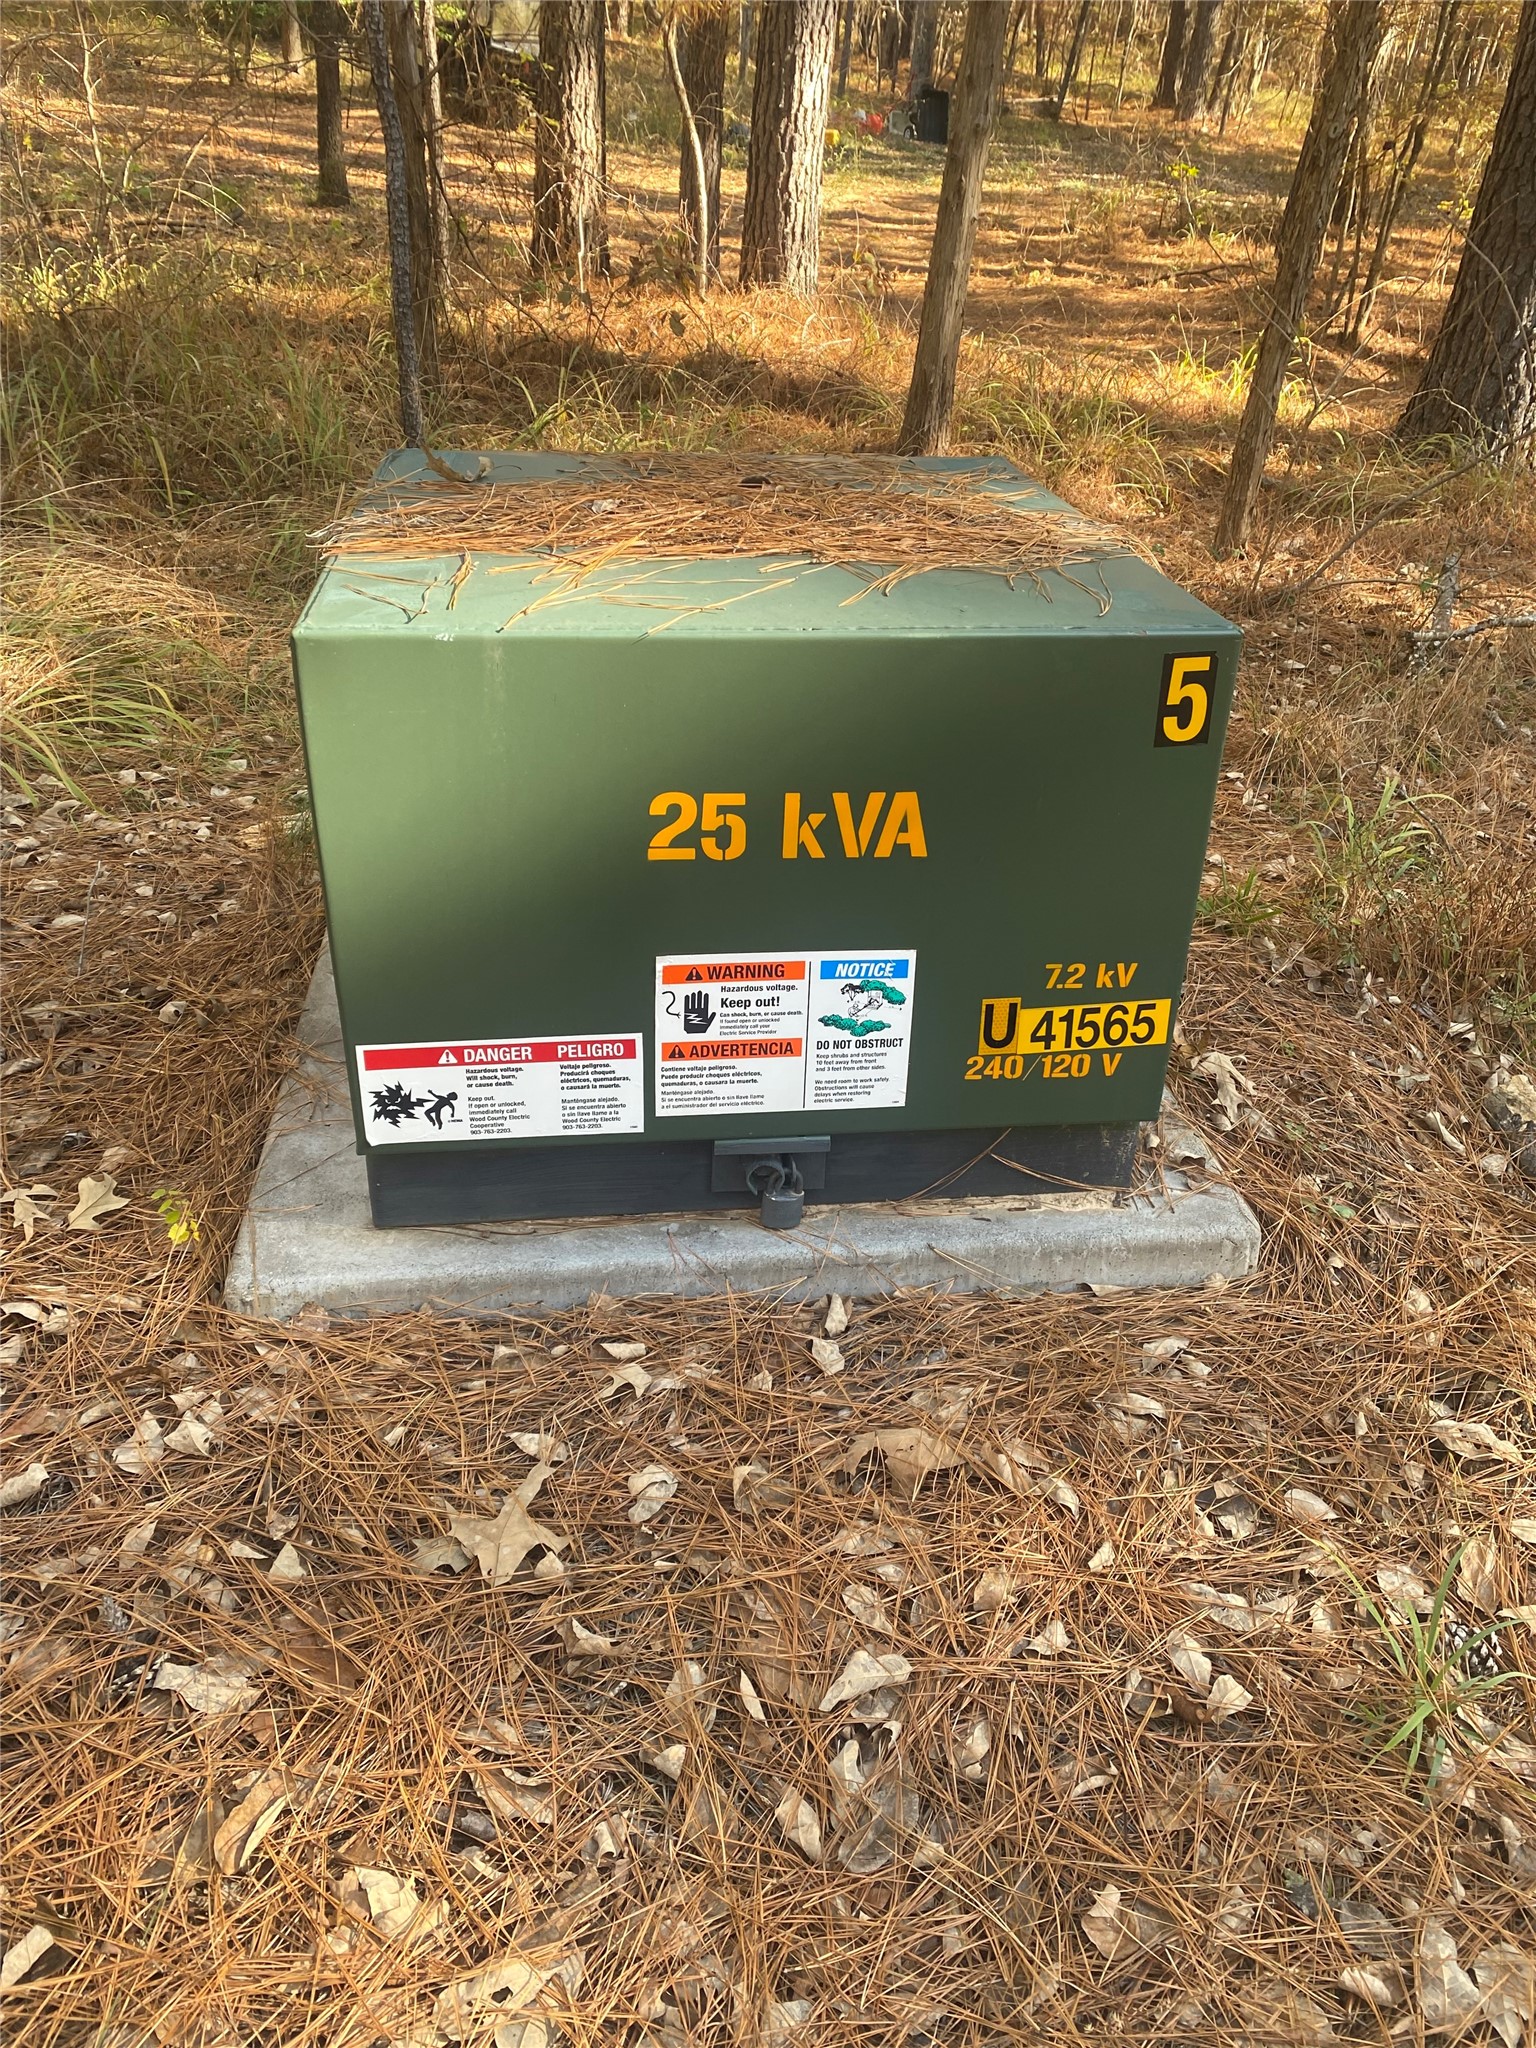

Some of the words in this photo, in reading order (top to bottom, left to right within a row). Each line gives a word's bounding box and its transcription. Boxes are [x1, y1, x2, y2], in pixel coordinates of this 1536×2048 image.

[1163, 656, 1212, 743] 5
[647, 792, 746, 861] 25
[782, 792, 928, 859] kVA
[707, 964, 785, 979] WARNING
[835, 963, 896, 977] NOTICE
[1045, 963, 1086, 989] 7.2
[1096, 963, 1138, 989] kV
[766, 984, 798, 992] voltage.
[721, 998, 750, 1009] Keep
[756, 996, 780, 1007] out!
[983, 1003, 1018, 1049] U
[1030, 1003, 1156, 1050] 41565
[557, 1043, 624, 1058] PELIGRO
[689, 1041, 794, 1058] ADVERTENCIA
[816, 1040, 829, 1050] DO
[833, 1040, 852, 1049] NOT
[855, 1038, 903, 1048] OBSTRUCT
[464, 1047, 532, 1062] DANGER
[964, 1053, 1091, 1081] 240/120
[1102, 1053, 1122, 1077] V
